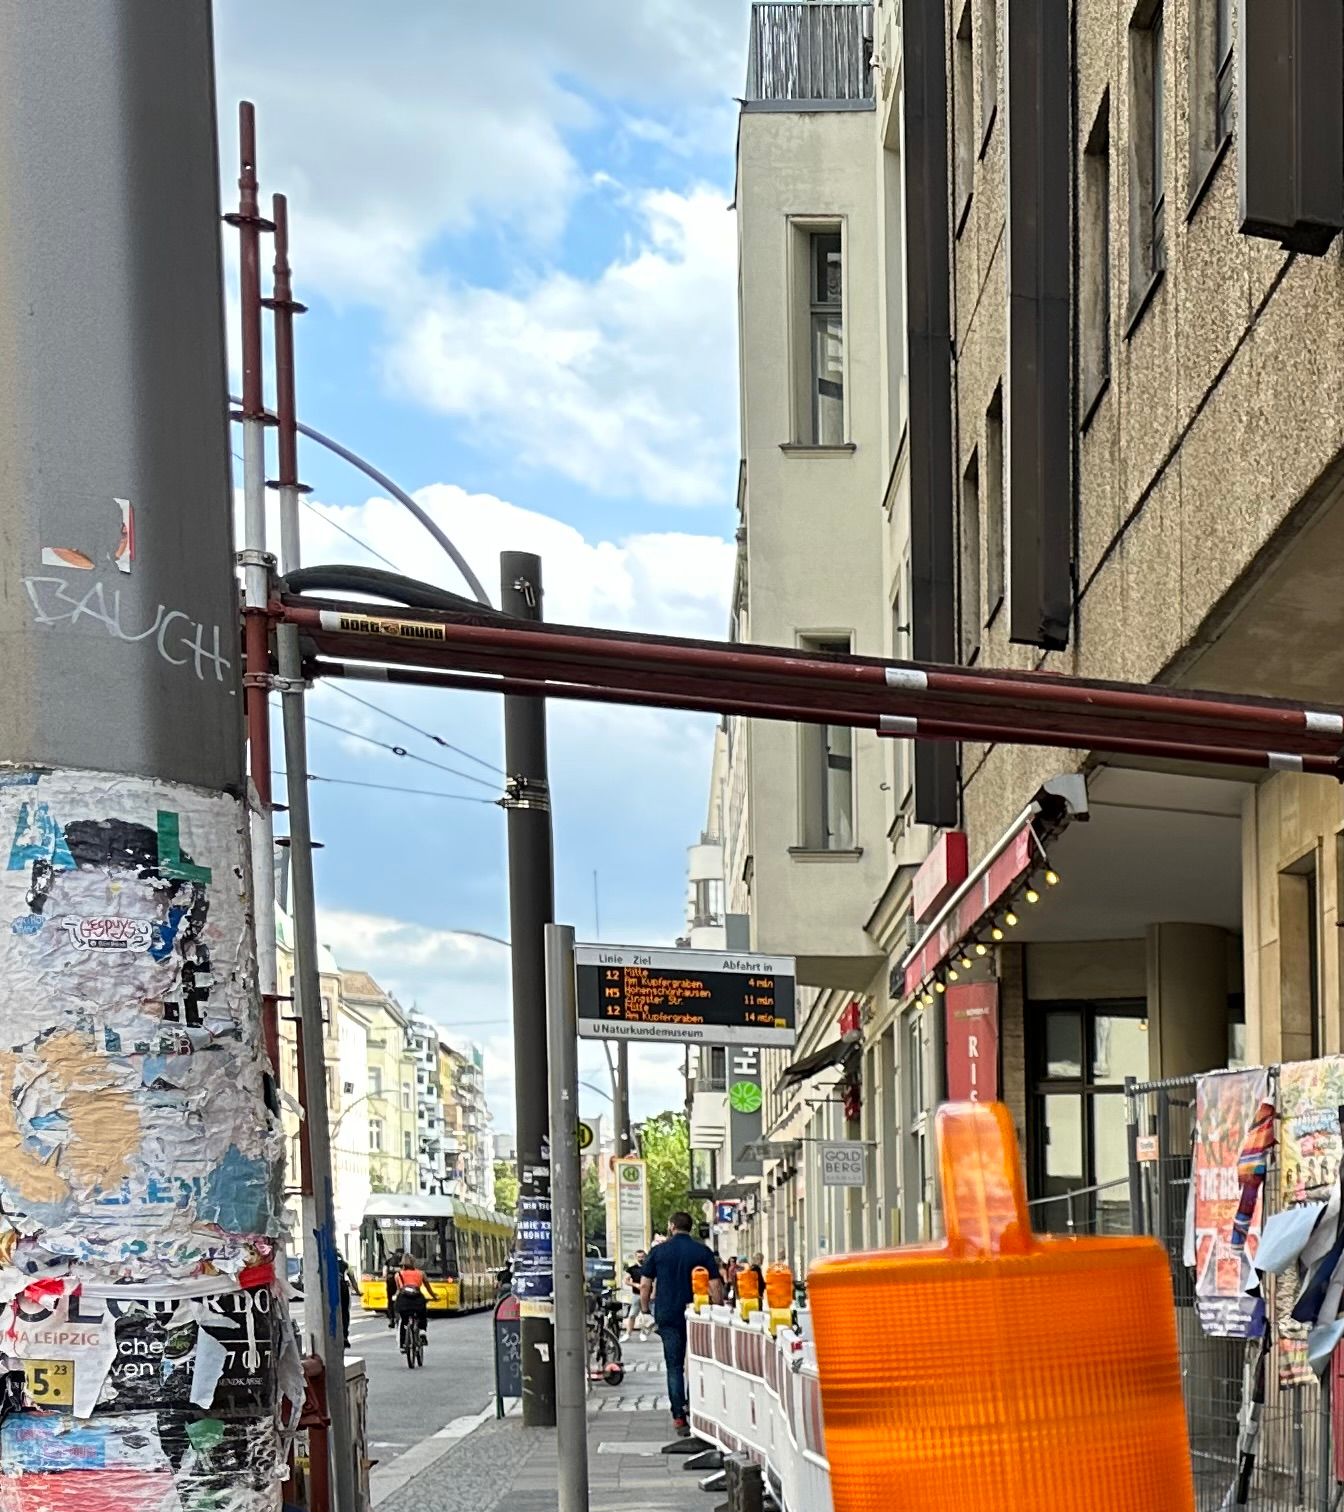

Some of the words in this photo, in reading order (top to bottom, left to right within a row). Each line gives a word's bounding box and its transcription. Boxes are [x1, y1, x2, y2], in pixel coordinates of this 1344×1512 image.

[598, 953, 624, 964] Linie
[633, 955, 652, 965] Ziel
[722, 960, 761, 972] Abfahrt
[763, 963, 773, 972] in
[605, 970, 620, 980] 12
[624, 967, 649, 977] Mitte
[748, 978, 755, 987] 4
[756, 979, 774, 988] min
[641, 978, 704, 990] Kupfergraben
[605, 987, 620, 998] M5
[744, 994, 755, 1005] 11
[756, 997, 774, 1006] min
[606, 1005, 621, 1016] 12
[744, 1012, 756, 1022] 14
[757, 1014, 775, 1023] min
[642, 1014, 705, 1025] Kupfergraben
[592, 1025, 600, 1033] U
[601, 1025, 704, 1038] Naturkundemuseum
[825, 1150, 861, 1162] GOLD
[825, 1162, 862, 1173] BERG
[34, 1330, 101, 1347] LEIPZIG
[53, 1364, 68, 1376] 23
